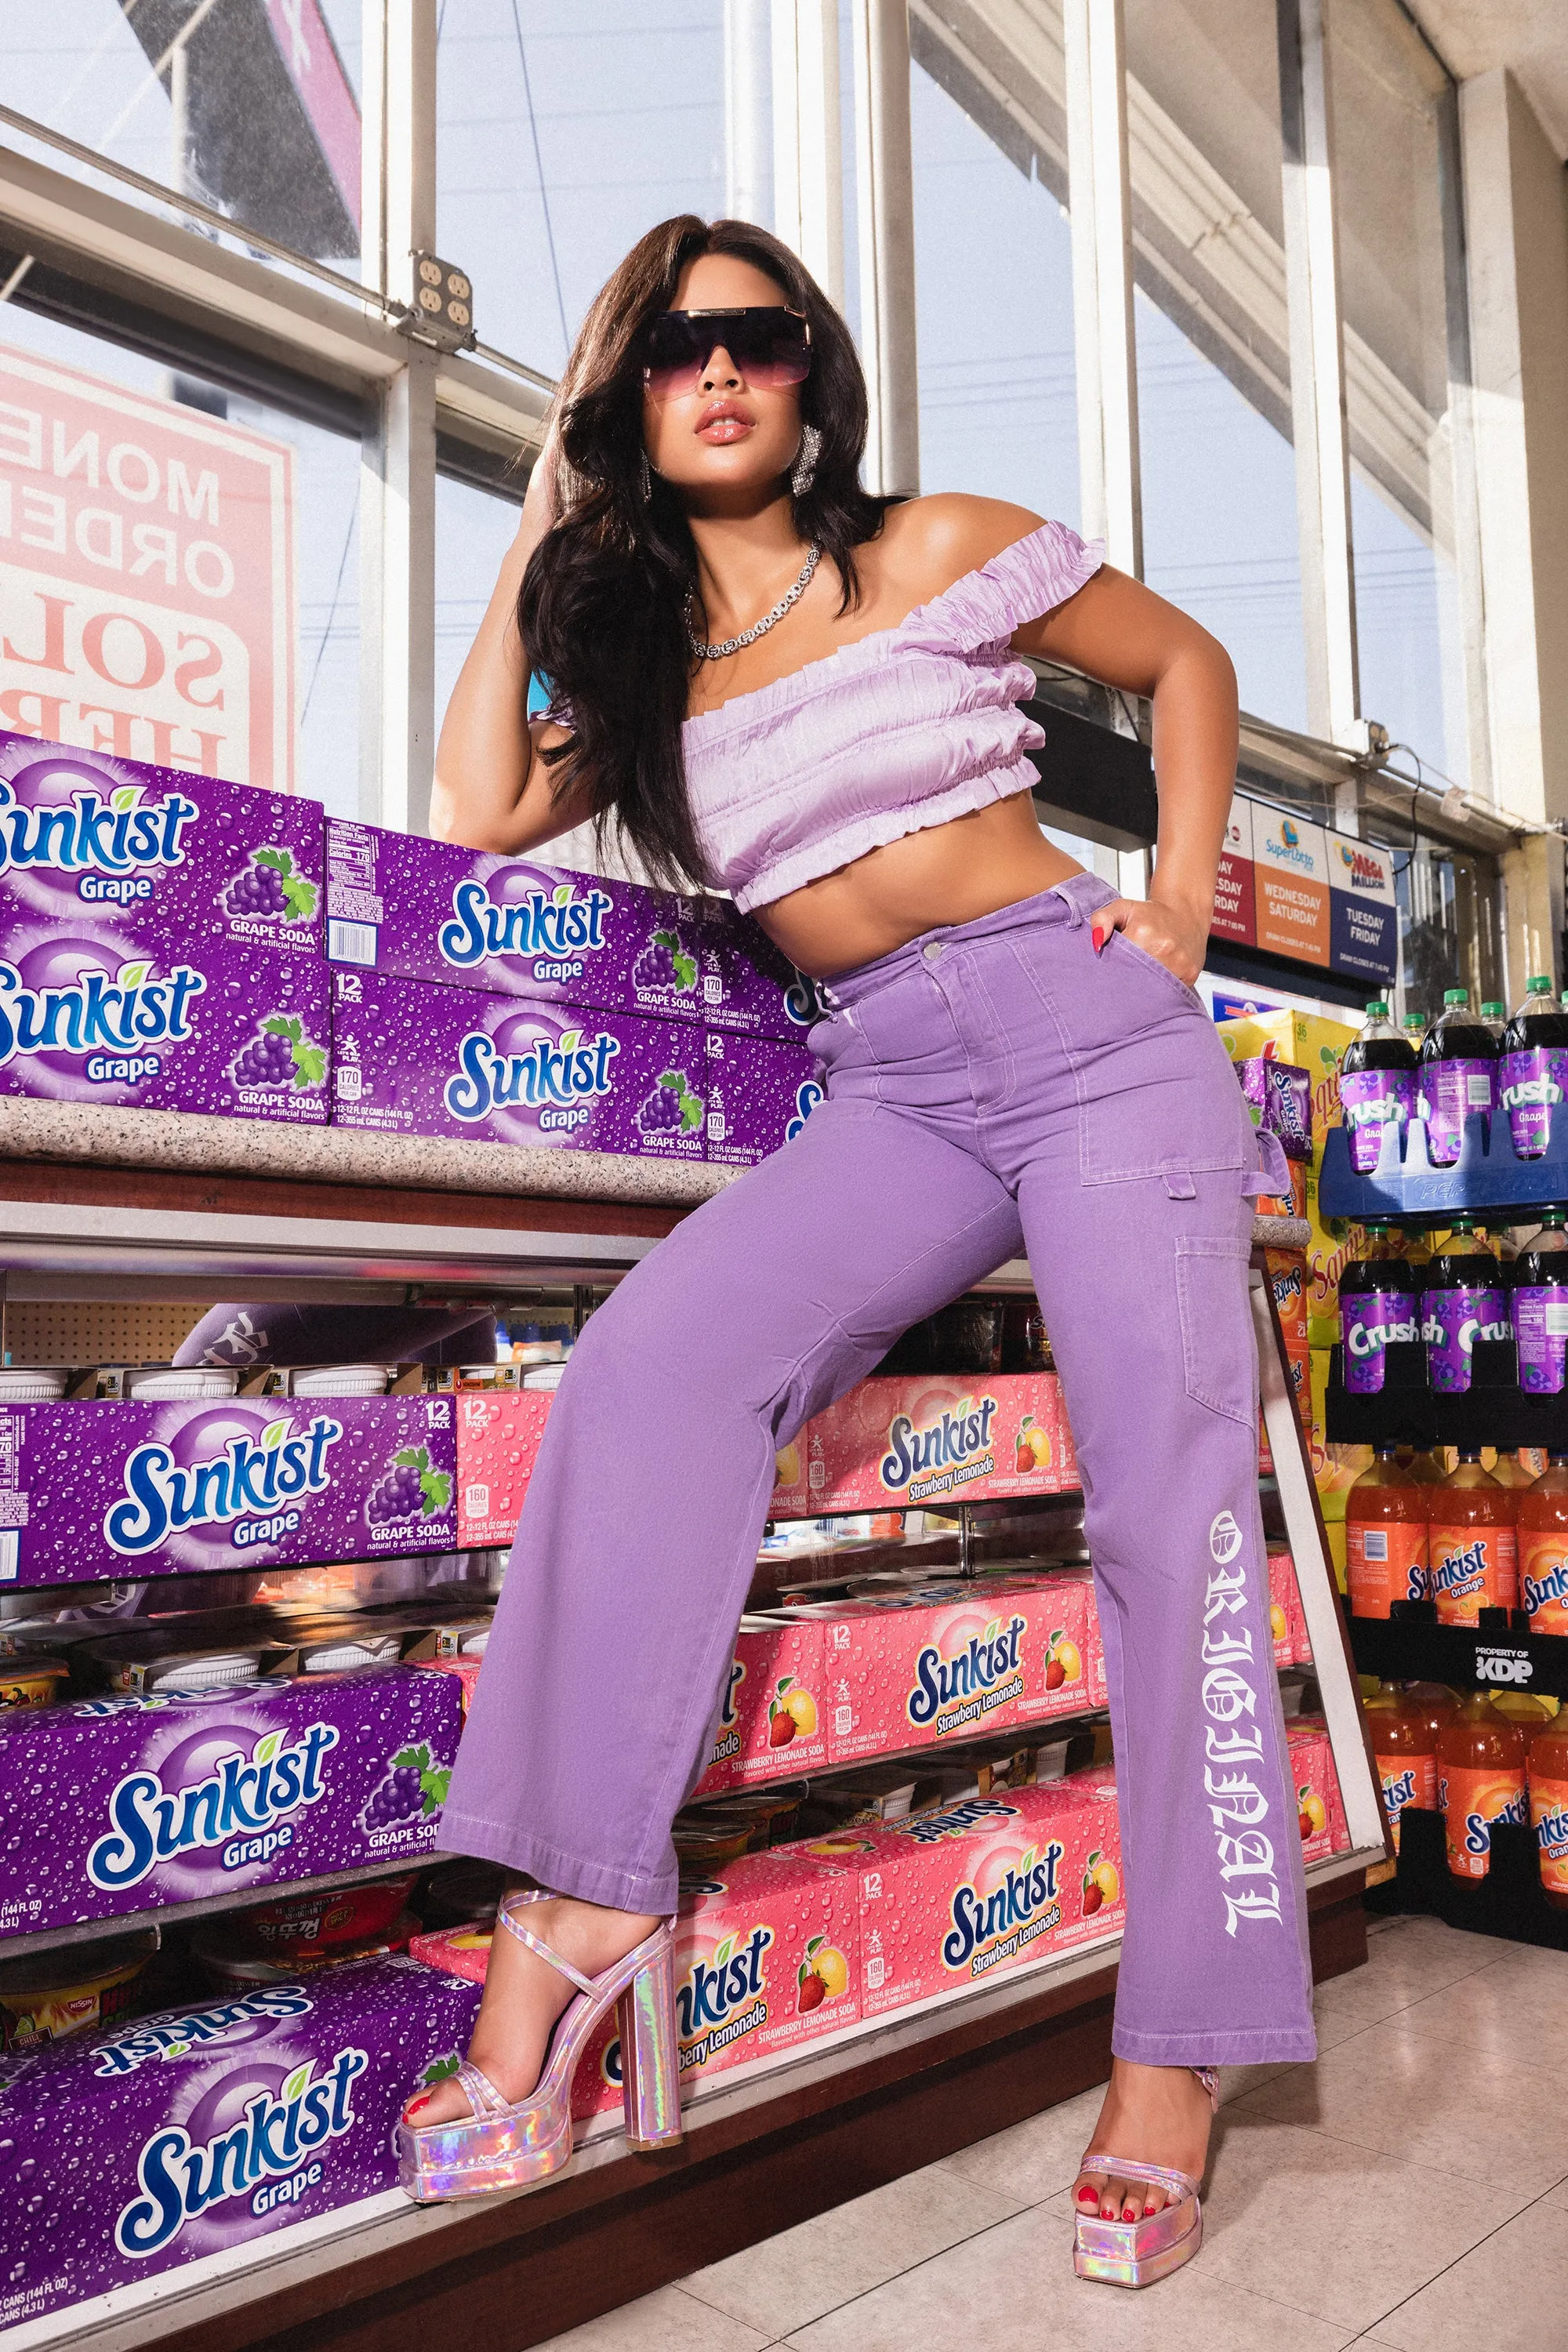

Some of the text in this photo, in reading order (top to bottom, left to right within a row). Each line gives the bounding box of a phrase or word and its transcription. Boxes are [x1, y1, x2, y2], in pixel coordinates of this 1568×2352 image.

[0, 793, 194, 870] unkist
[328, 828, 353, 839] Nutrition
[354, 833, 369, 842] Facts
[328, 848, 369, 861] Calories 170
[1267, 839, 1314, 867] SuperLotto
[81, 877, 151, 902] Grape
[1264, 882, 1321, 910] WEDNESDAY
[676, 898, 694, 915] 12
[1269, 902, 1317, 927] SATURDAY
[448, 884, 609, 962] Sunkist
[678, 913, 695, 923] PACK
[1346, 907, 1384, 930] TUESDAY
[226, 933, 251, 943] natural
[261, 938, 290, 950] artificial
[292, 943, 315, 953] flavors
[230, 920, 315, 945] GRAPE SODA
[1350, 927, 1381, 946] FRIDAY
[534, 960, 582, 981] Grape
[336, 974, 361, 995] 12
[706, 979, 720, 990] 170
[338, 993, 362, 1004] PACK
[637, 992, 696, 1011] GRAPE SODA
[1297, 1023, 1307, 1037] 36
[707, 1035, 724, 1051] 12
[88, 1054, 158, 1081] Grape
[341, 1071, 358, 1083] 170
[449, 1034, 618, 1116] Sunkist
[238, 1091, 325, 1111] GRAPE SODA
[1276, 1072, 1305, 1141] Sunkist
[234, 1105, 260, 1114] natural
[270, 1108, 299, 1118] artificial
[301, 1110, 325, 1120] flavors
[540, 1108, 587, 1128] Grape
[710, 1116, 723, 1127] 170
[1281, 1109, 1290, 1132] Grape
[1519, 1113, 1548, 1123] Grape
[643, 1135, 702, 1152] GRAPE SODA
[1349, 1317, 1419, 1355] Crush
[426, 1401, 450, 1421] 12
[464, 1400, 487, 1420] 12
[428, 1421, 451, 1429] PACK
[883, 1399, 996, 1488] Sunkist
[811, 1465, 823, 1475] 160
[909, 1454, 993, 1501] Strawberry Lemonade
[111, 1420, 339, 1548] Sunkist
[989, 1478, 1019, 1489] STRAWBERRY
[1020, 1476, 1044, 1486] LEMONADE
[1044, 1475, 1057, 1484] SODA
[469, 1489, 486, 1501] 160
[235, 1512, 298, 1545] Grape
[372, 1524, 450, 1541] GRAPE SODA
[367, 1541, 391, 1550] natural
[400, 1537, 427, 1548] artificial
[429, 1536, 450, 1545] flavors
[1430, 1542, 1486, 1599] unkist
[1451, 1577, 1484, 1599] Orange
[833, 1625, 850, 1643] 12
[1475, 1646, 1515, 1657] PROPERTY
[909, 1617, 1025, 1723] Sunkist
[1476, 1657, 1534, 1684] KDP
[937, 1676, 1023, 1736] Strawberry Lemonade
[1018, 1689, 1087, 1711] STRAWBERRY LEMONADE SODA
[838, 1709, 850, 1721] 160
[731, 1744, 825, 1773] STRAWBERRY LEMONADE SODA
[744, 1755, 826, 1778] flavored with other natural flavors
[93, 1726, 335, 1885] Sunkist
[224, 1827, 292, 1867] Grape
[365, 1846, 390, 1858] natural
[399, 1839, 427, 1852] artificial
[369, 1828, 414, 1848] GRAPE
[864, 1873, 881, 1893] 12
[866, 1891, 882, 1900] PACK
[945, 1844, 1062, 1966] Sunkist
[2, 1900, 42, 1918] (144 FL OZ)
[12, 1916, 19, 1928] L)
[1054, 1924, 1085, 1941] STRAWBERRY
[1086, 1915, 1112, 1930] LEMONADE
[1112, 1909, 1125, 1921] SODA
[972, 1939, 1018, 1976] Strawberry
[1019, 1906, 1060, 1947] Lemonade
[869, 1962, 882, 1975] 160
[71, 1999, 93, 2009] NISSIN
[93, 1987, 310, 2074] Sunkist
[109, 2014, 176, 2038] Grape
[710, 2005, 766, 2052] Lemonade
[759, 2002, 856, 2044] STRAWBERRY LEMONADE SODA
[771, 2014, 856, 2048] flavored with other natural flavors
[20, 2034, 39, 2045] CHILI
[121, 2053, 364, 2252] Sunkist
[253, 2165, 321, 2215] Grape
[3, 2277, 68, 2309] CANS (144 FL OZ)
[0, 2299, 45, 2325] CANS (4.3 L)
